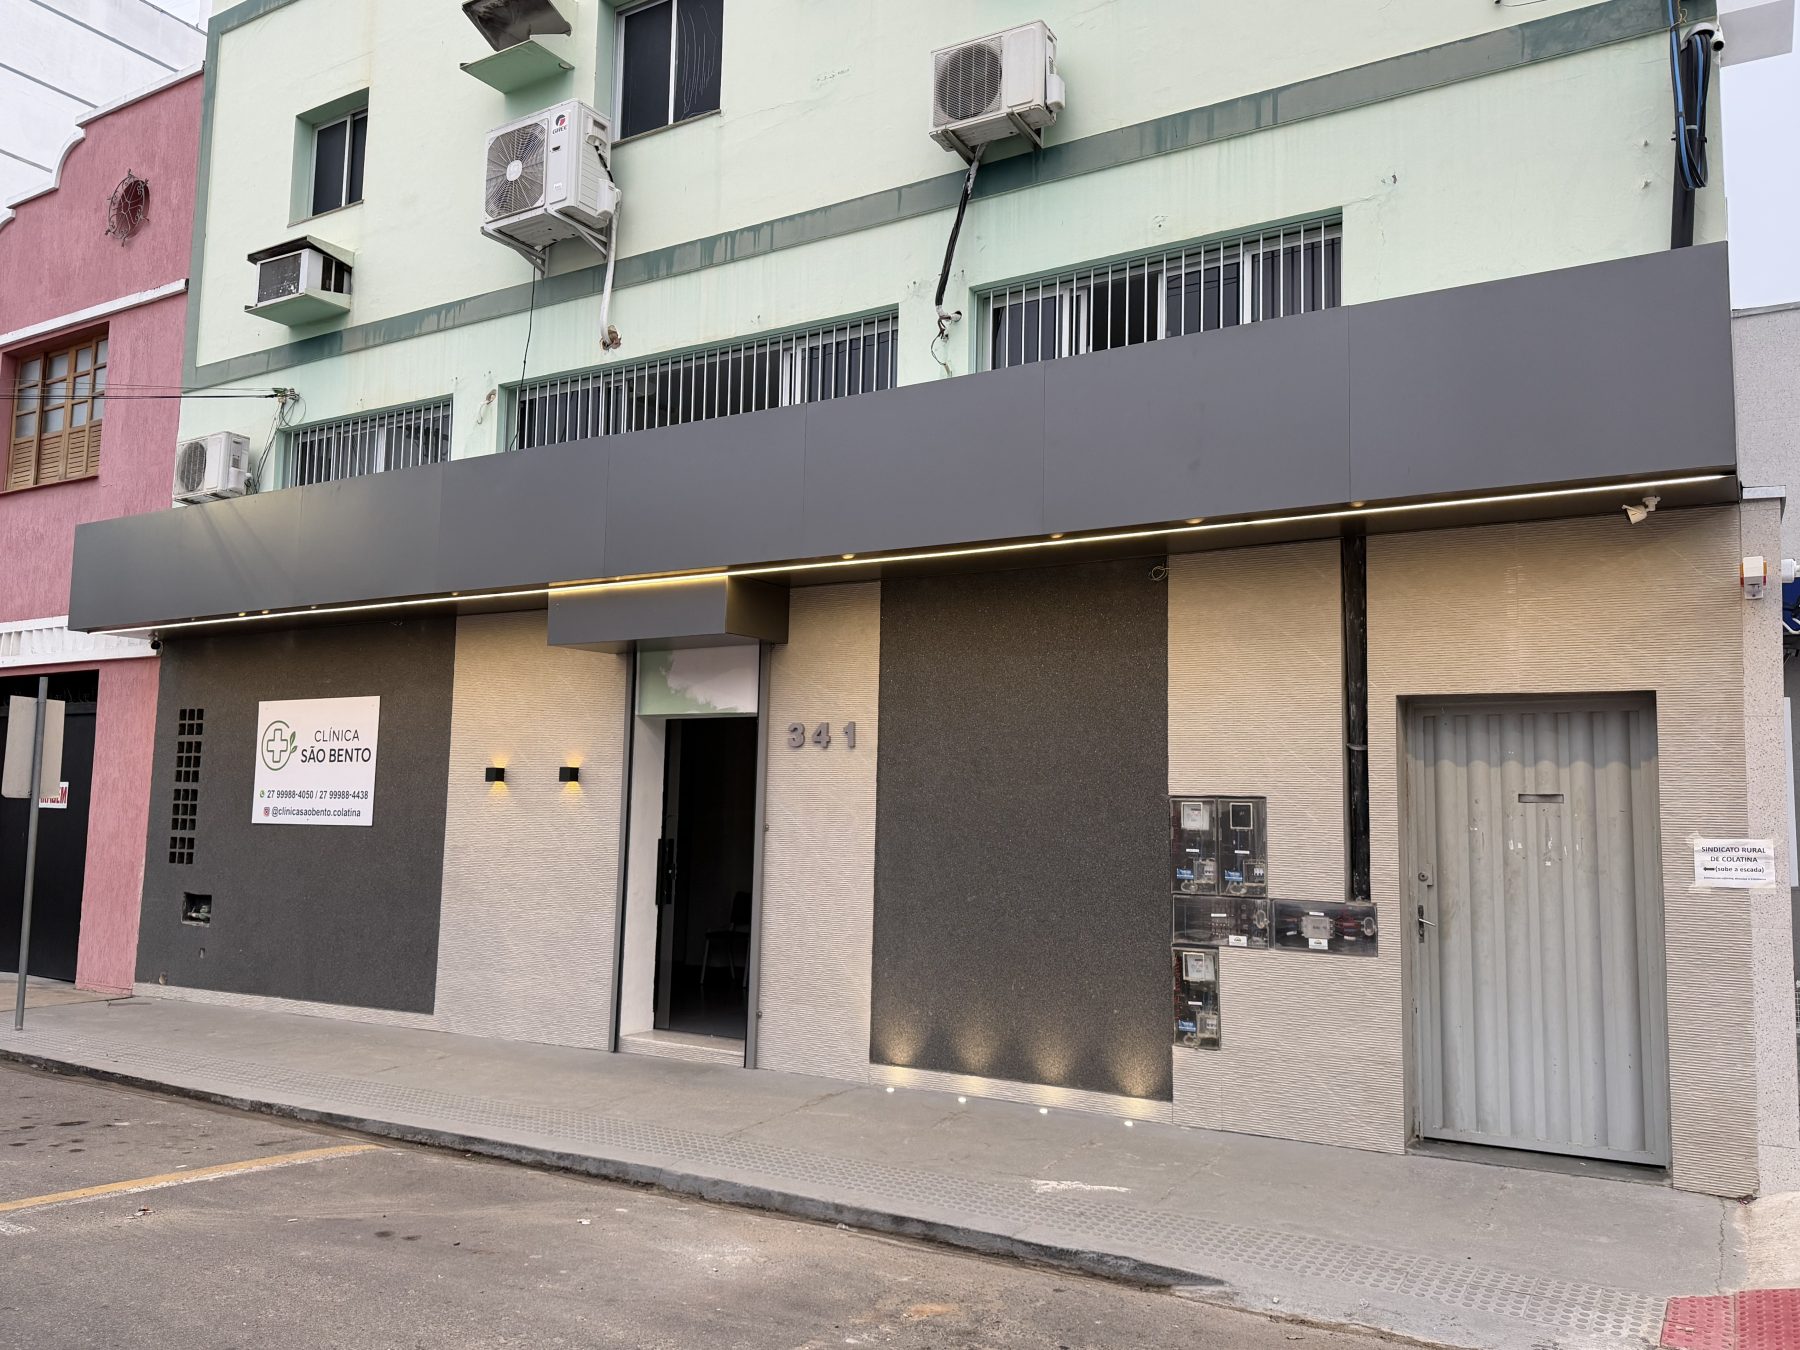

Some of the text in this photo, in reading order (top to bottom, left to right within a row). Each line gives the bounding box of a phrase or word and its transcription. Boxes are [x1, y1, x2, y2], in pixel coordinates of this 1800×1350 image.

[314, 726, 360, 742] CLÍNICA
[788, 721, 856, 749] 341
[300, 745, 372, 763] SÃO BENTO
[267, 789, 275, 799] 27
[276, 789, 314, 799] 99988-4050
[319, 790, 327, 800] 27
[271, 806, 361, 818] @clinicasaobento.colatina
